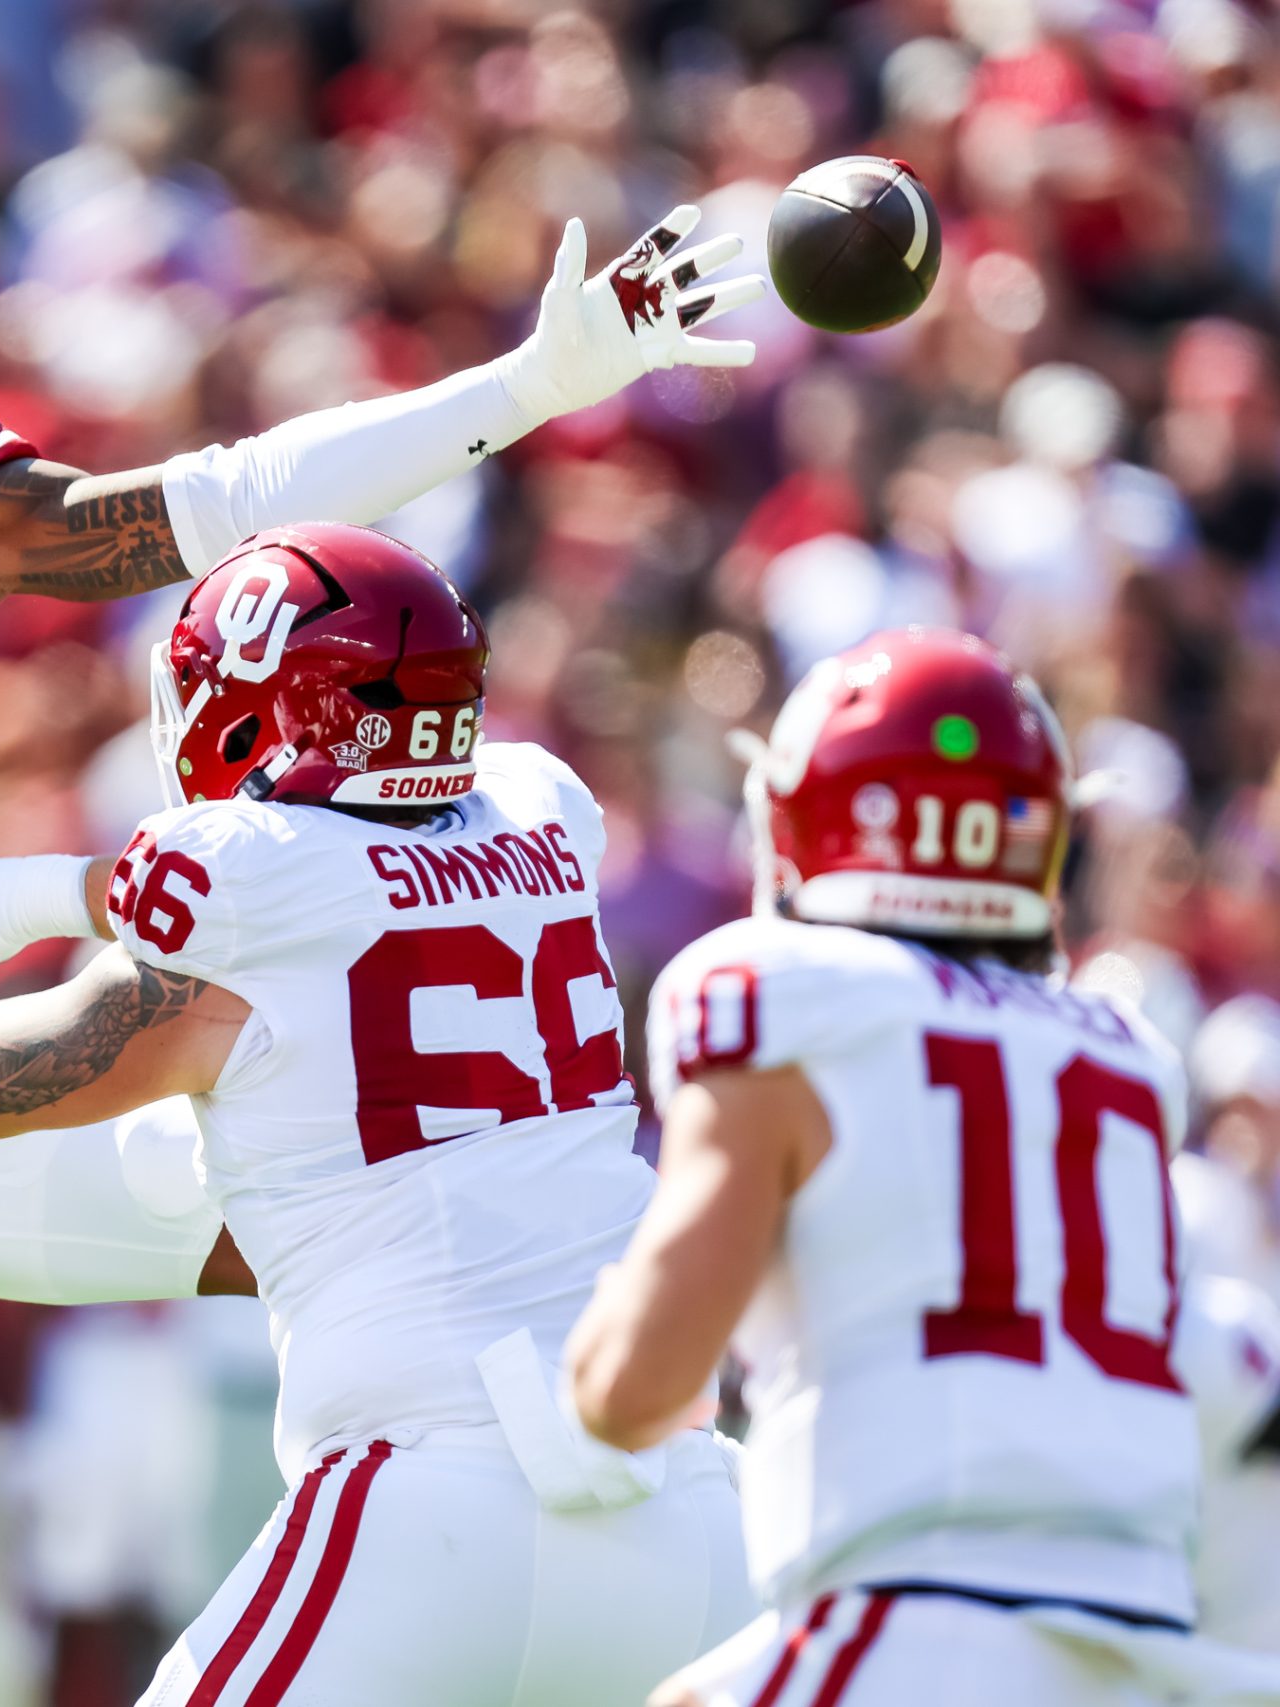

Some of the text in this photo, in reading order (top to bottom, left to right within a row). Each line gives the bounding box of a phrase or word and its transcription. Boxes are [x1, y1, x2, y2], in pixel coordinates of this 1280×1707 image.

[336, 759, 360, 770] GRAD
[360, 718, 388, 745] SEC
[409, 707, 474, 760] 66
[367, 822, 585, 909] SIMMONS
[914, 795, 1000, 867] 10
[106, 830, 212, 955] 66
[347, 915, 641, 1166] 66
[923, 1027, 1190, 1396] 10
